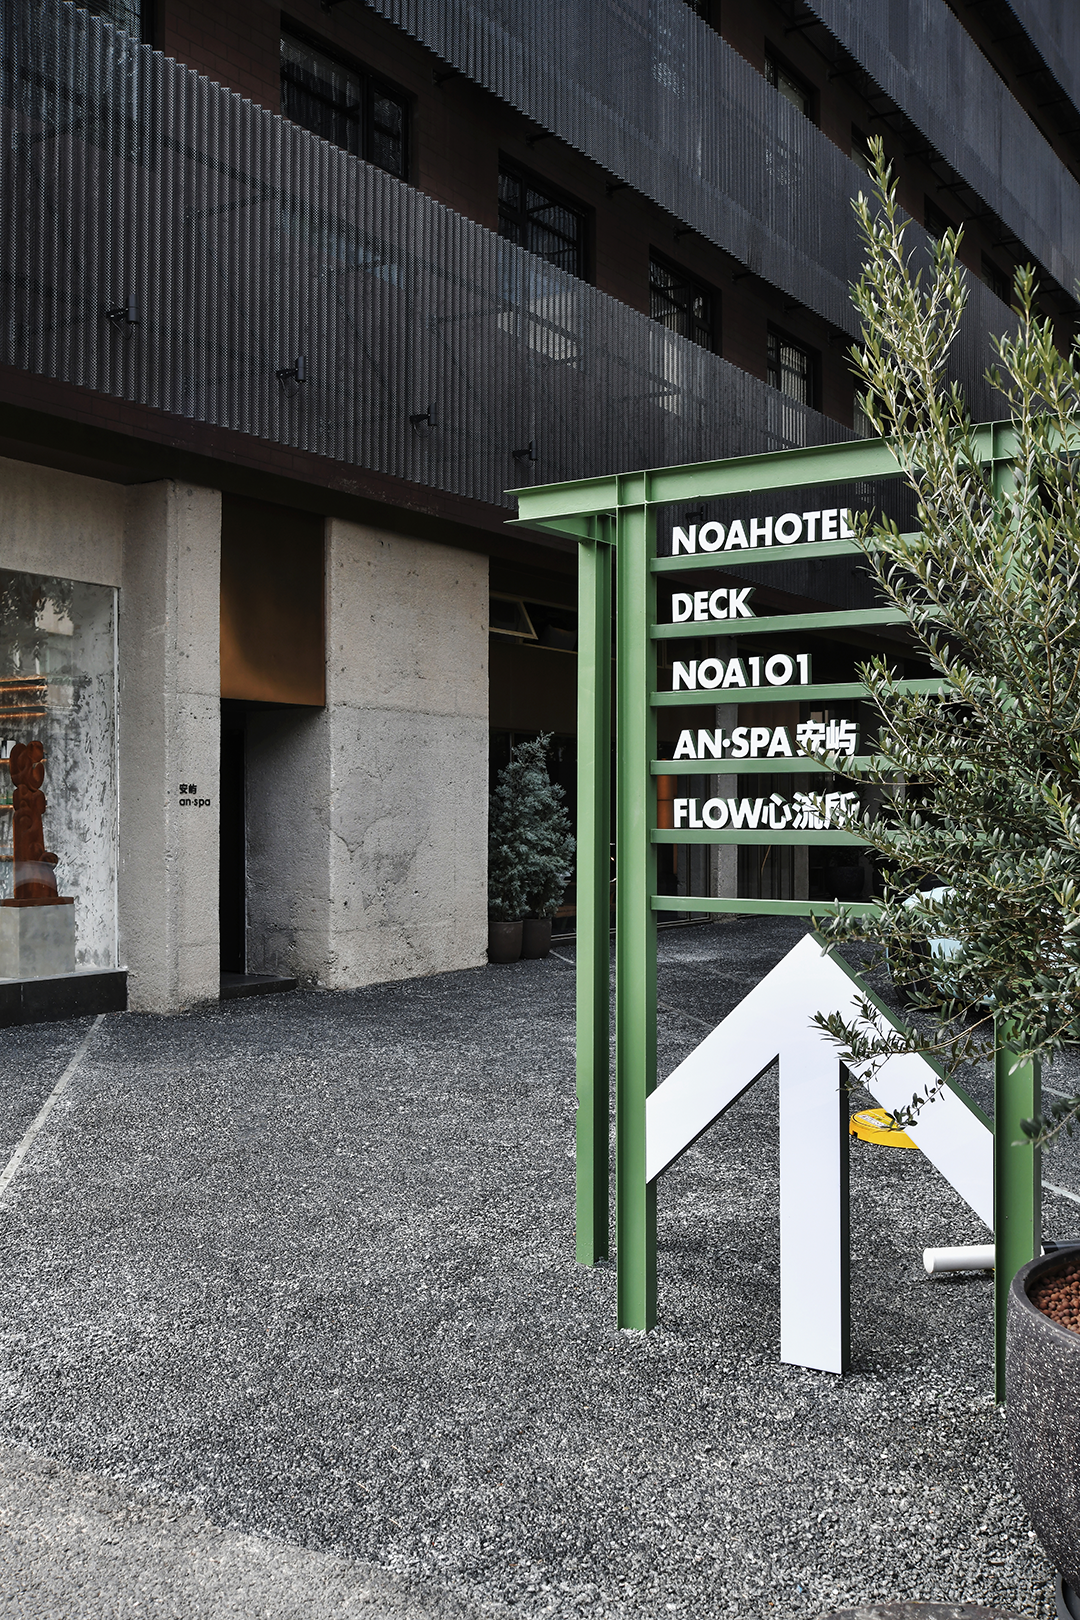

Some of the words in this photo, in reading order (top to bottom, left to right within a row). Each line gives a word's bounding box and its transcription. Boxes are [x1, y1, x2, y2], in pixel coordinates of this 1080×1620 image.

[672, 508, 855, 555] NOAHOTEL
[672, 588, 754, 622] DECK
[672, 654, 810, 690] NOA101
[673, 727, 792, 759] AN·SPA
[796, 720, 858, 756] 安屿
